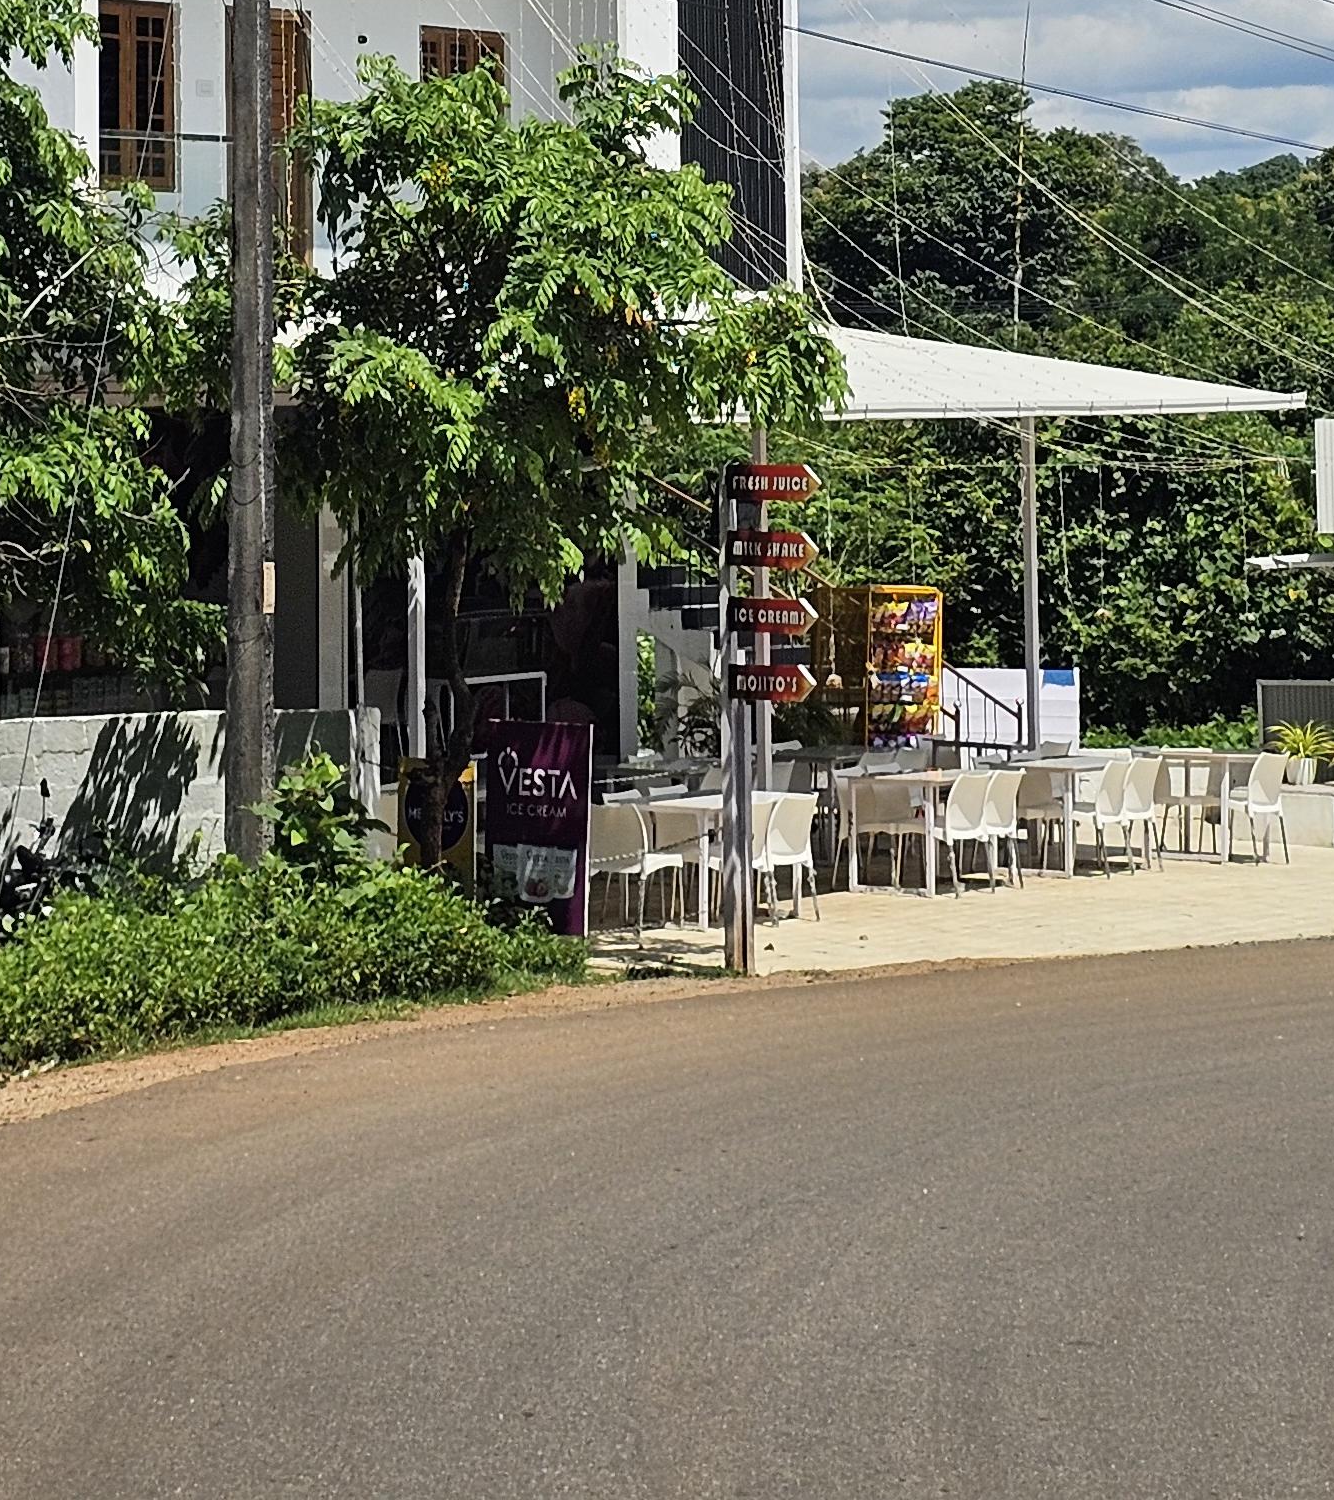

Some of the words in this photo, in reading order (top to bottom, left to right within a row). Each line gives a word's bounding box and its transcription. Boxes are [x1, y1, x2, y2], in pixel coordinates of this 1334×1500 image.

[732, 475, 768, 491] FRESH
[772, 476, 809, 492] JUICE
[732, 540, 762, 557] MILK
[766, 542, 805, 558] SHAKE
[734, 607, 754, 623] ICE
[757, 608, 806, 626] CREAMS
[736, 674, 798, 693] MOJITO'S
[497, 746, 578, 801] VESTA
[506, 802, 526, 816] ICE
[527, 803, 567, 818] CREAM
